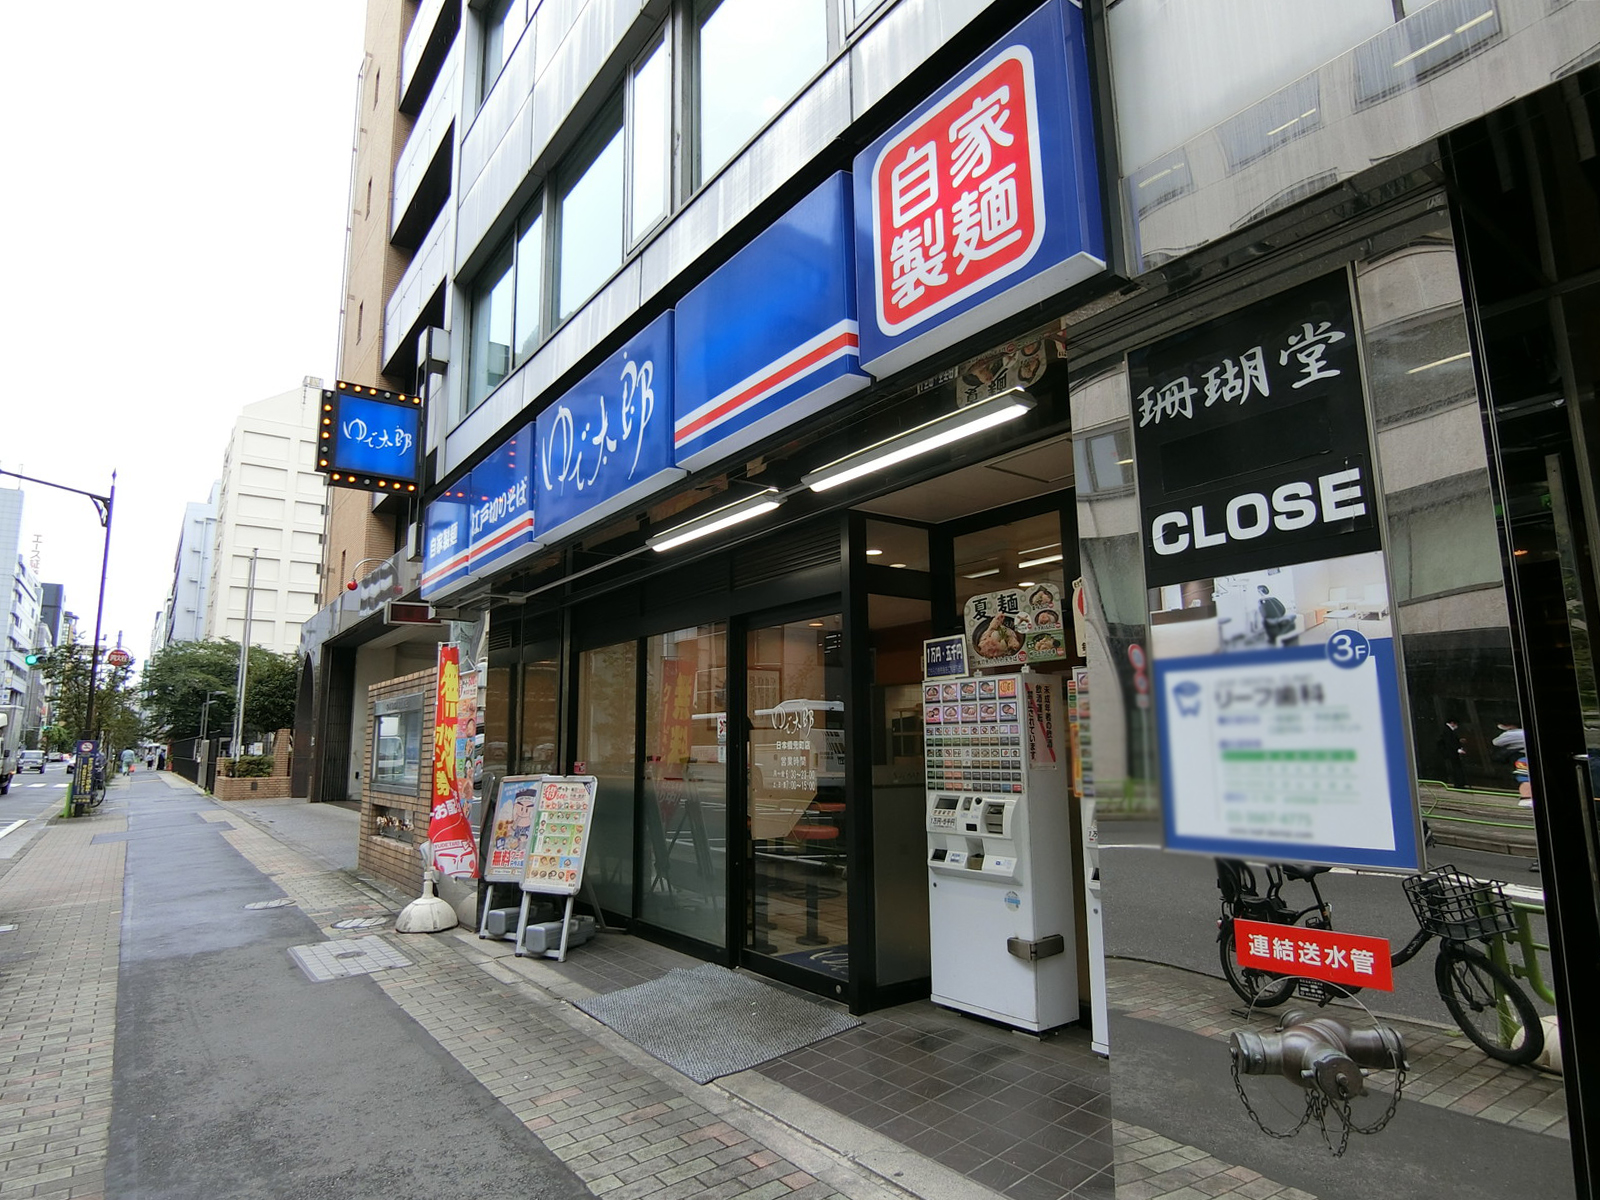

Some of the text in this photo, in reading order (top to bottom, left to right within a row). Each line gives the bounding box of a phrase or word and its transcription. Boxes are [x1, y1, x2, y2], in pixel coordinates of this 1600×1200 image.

[1136, 321, 1346, 429] 珊瑚堂
[342, 417, 413, 456] ゆで太郎
[541, 351, 655, 496] ゆで太郎
[471, 476, 528, 539] 江戸切りそば
[1151, 467, 1366, 556] CLOSE
[429, 520, 459, 560] 自家製麺
[972, 592, 1020, 621] 夏麺
[1331, 634, 1367, 662] 3F
[1248, 932, 1375, 976] 連結送水管
